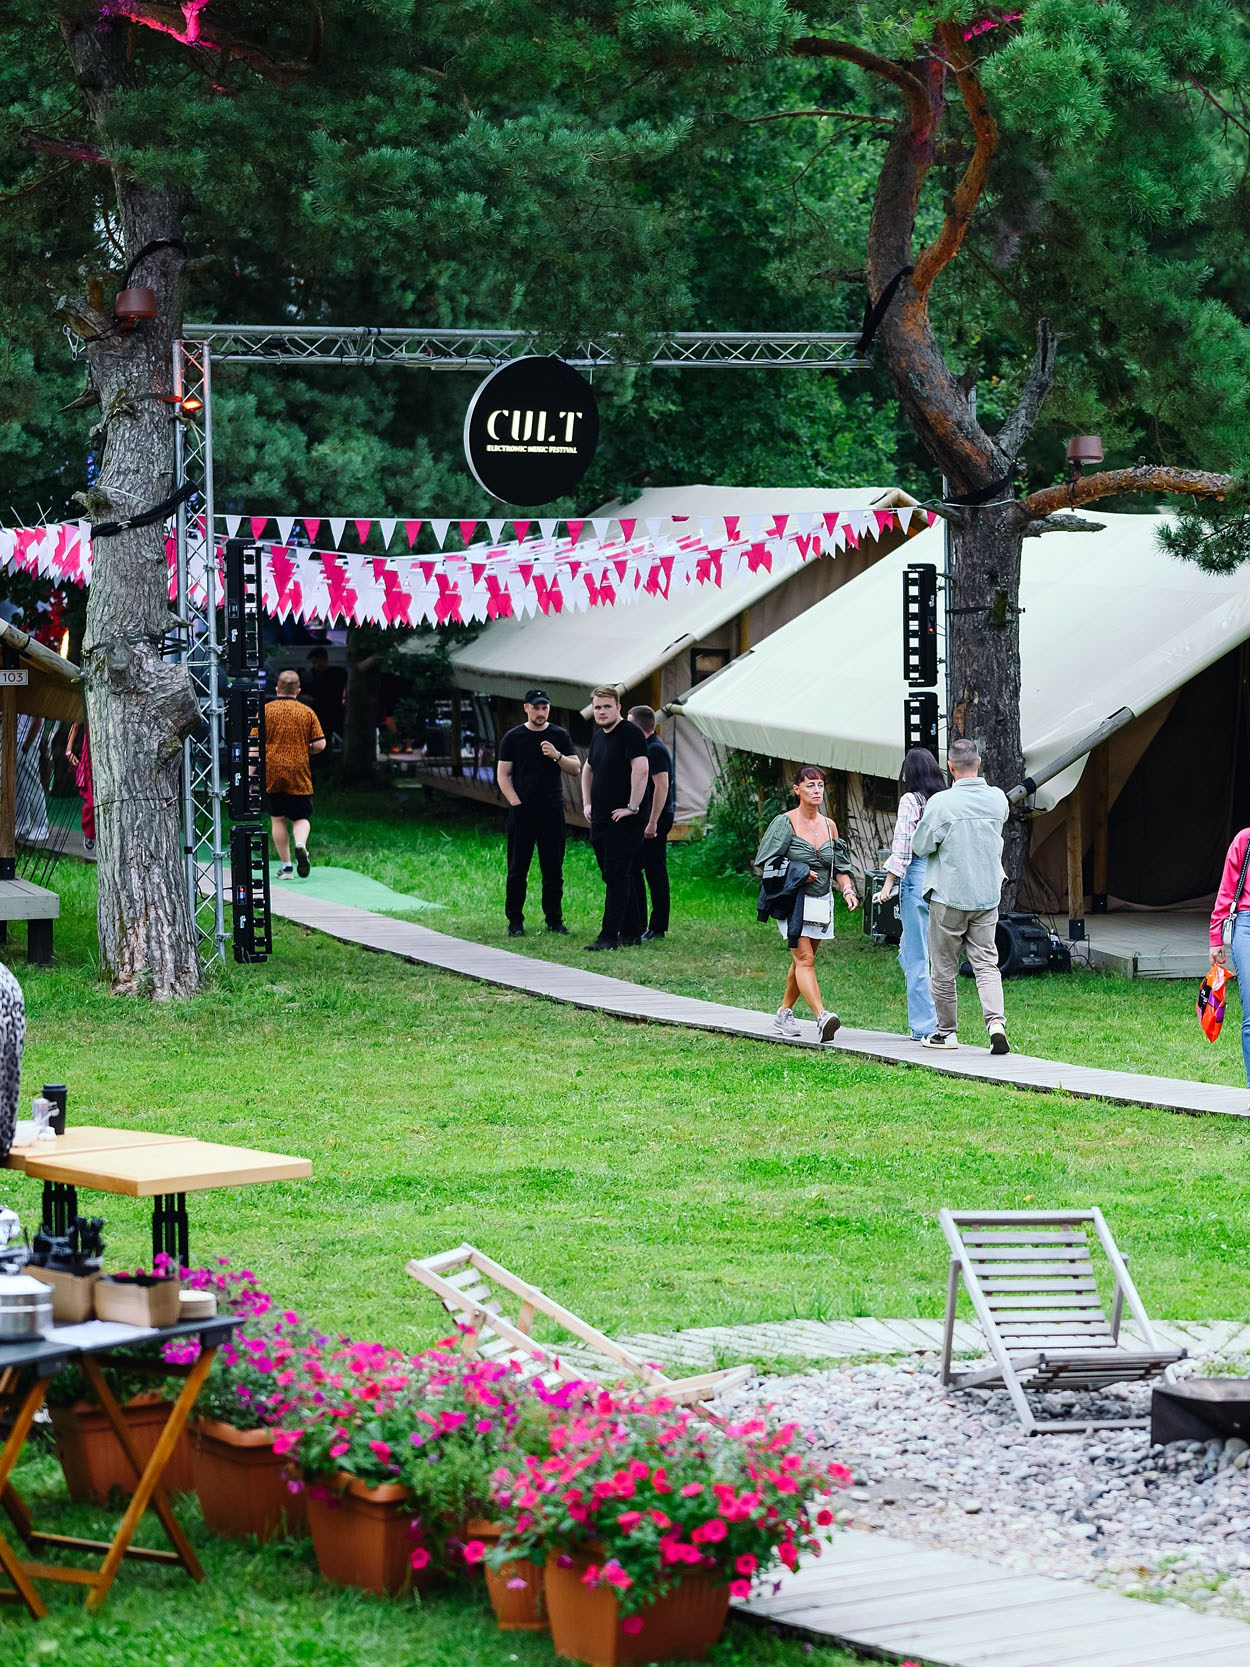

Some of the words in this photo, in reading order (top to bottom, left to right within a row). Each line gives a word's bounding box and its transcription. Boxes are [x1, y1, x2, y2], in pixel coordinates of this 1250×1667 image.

[486, 410, 583, 442] CULT
[486, 445, 527, 453] ELECTRONIC
[549, 446, 578, 454] FESTIVAL
[3, 672, 23, 683] 103
